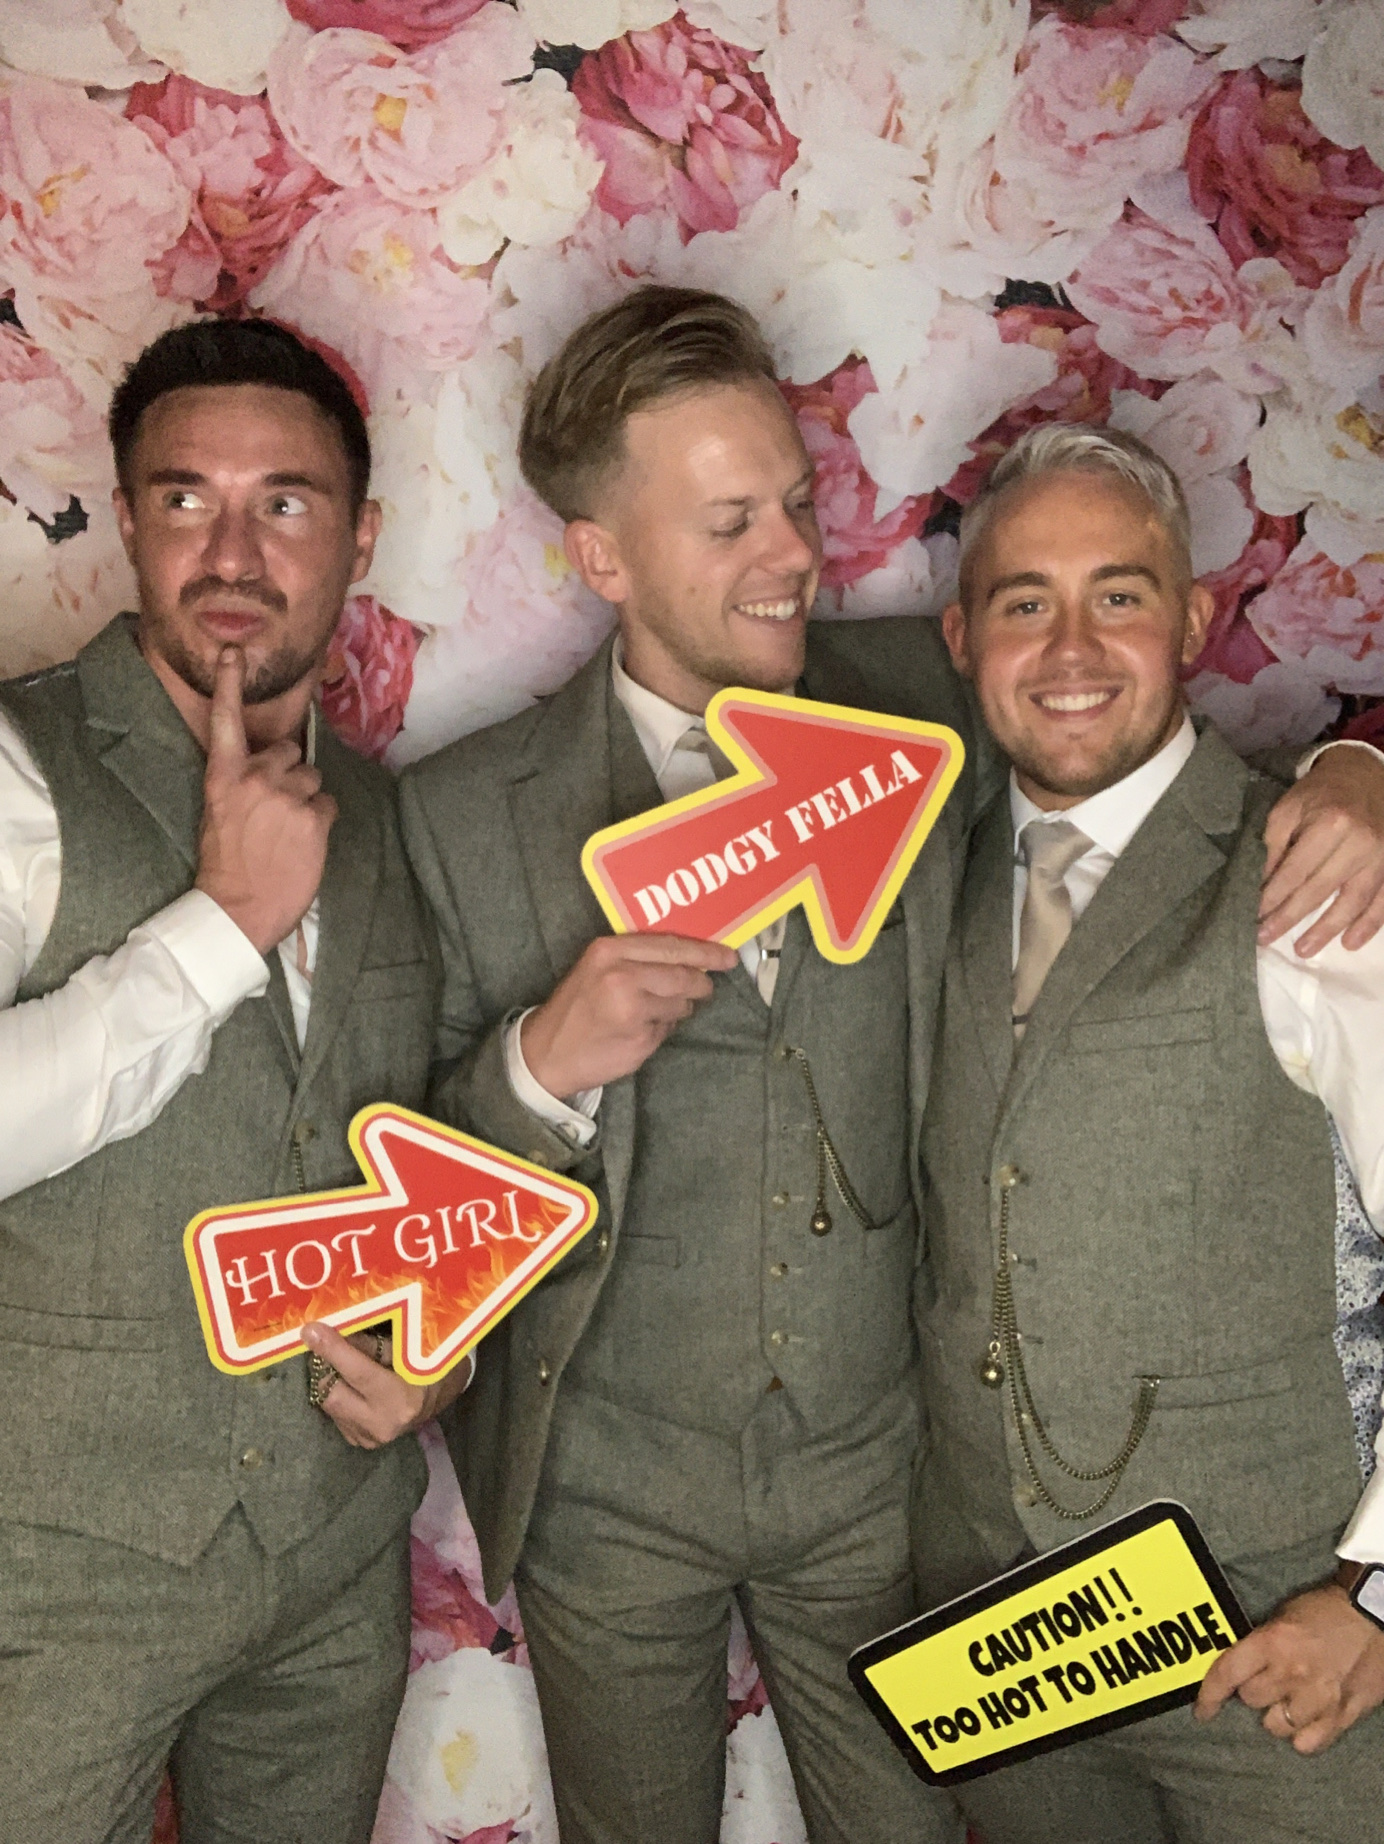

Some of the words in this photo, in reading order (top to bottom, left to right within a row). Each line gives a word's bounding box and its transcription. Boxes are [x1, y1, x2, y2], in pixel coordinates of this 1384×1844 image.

[633, 820, 781, 927] DODGY
[784, 749, 923, 844] FELLA
[225, 1224, 376, 1306] HOT
[393, 1190, 542, 1269] GIRL
[911, 1706, 982, 1751] TOO
[978, 1674, 1050, 1730] HOT
[1042, 1661, 1096, 1704] TO
[1088, 1601, 1232, 1690] HANDLE
[968, 1567, 1143, 1677] CAUTION!!
